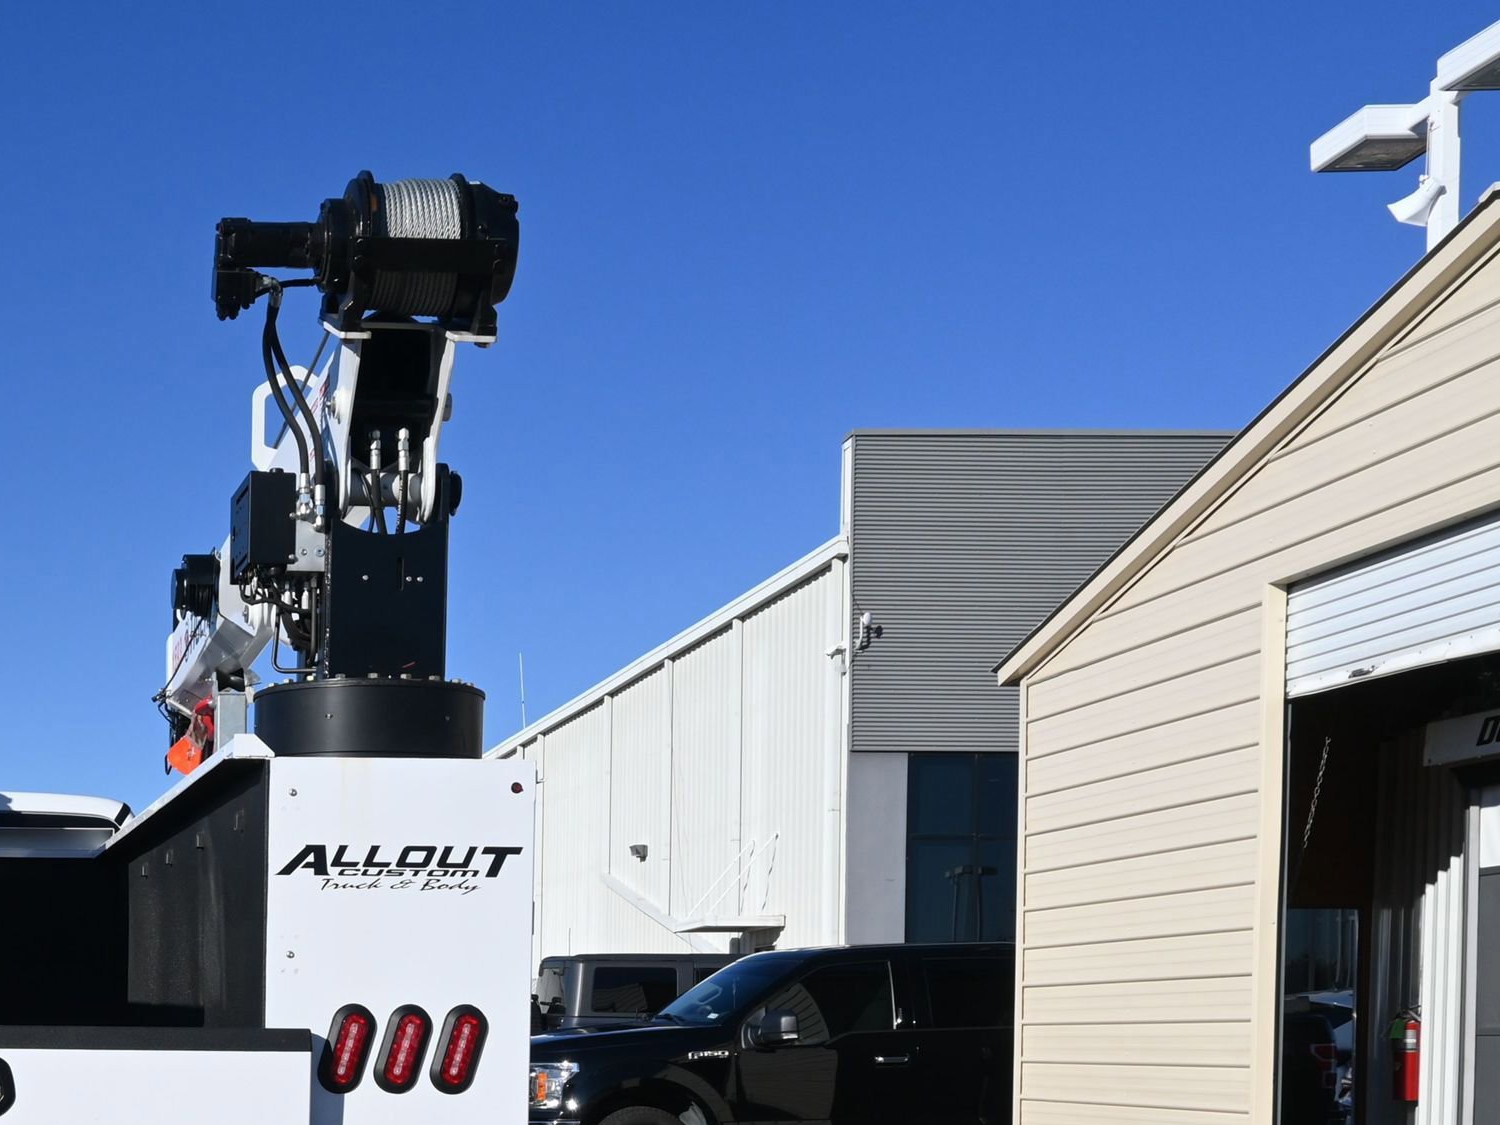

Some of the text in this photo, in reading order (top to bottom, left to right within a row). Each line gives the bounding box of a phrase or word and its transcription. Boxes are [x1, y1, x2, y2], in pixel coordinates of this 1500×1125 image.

[274, 844, 524, 878] ALLOUT
[337, 868, 481, 878] CUSTOM
[321, 878, 482, 896] Truck & Body
